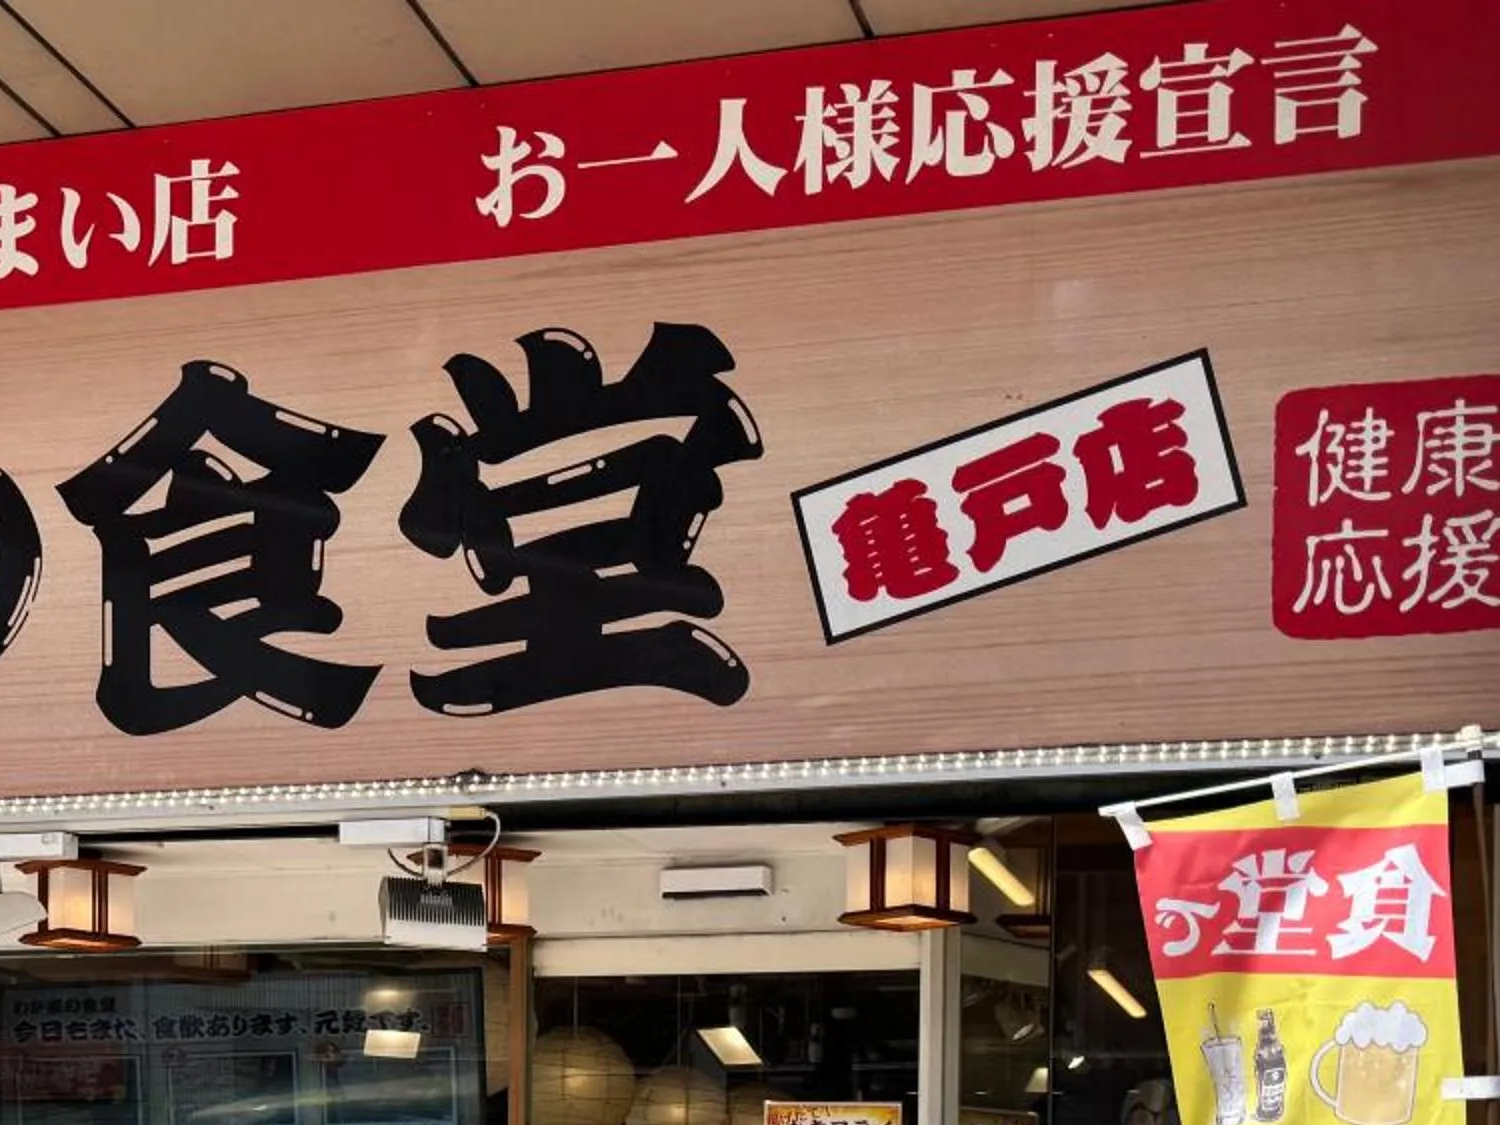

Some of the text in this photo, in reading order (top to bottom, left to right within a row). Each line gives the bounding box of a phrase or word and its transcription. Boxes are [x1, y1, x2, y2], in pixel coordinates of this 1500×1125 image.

[474, 22, 1379, 229] お一人様応援宣言
[831, 395, 1199, 603] 亀戸店
[1294, 398, 1500, 507] 健康
[1291, 518, 1500, 616] 応援
